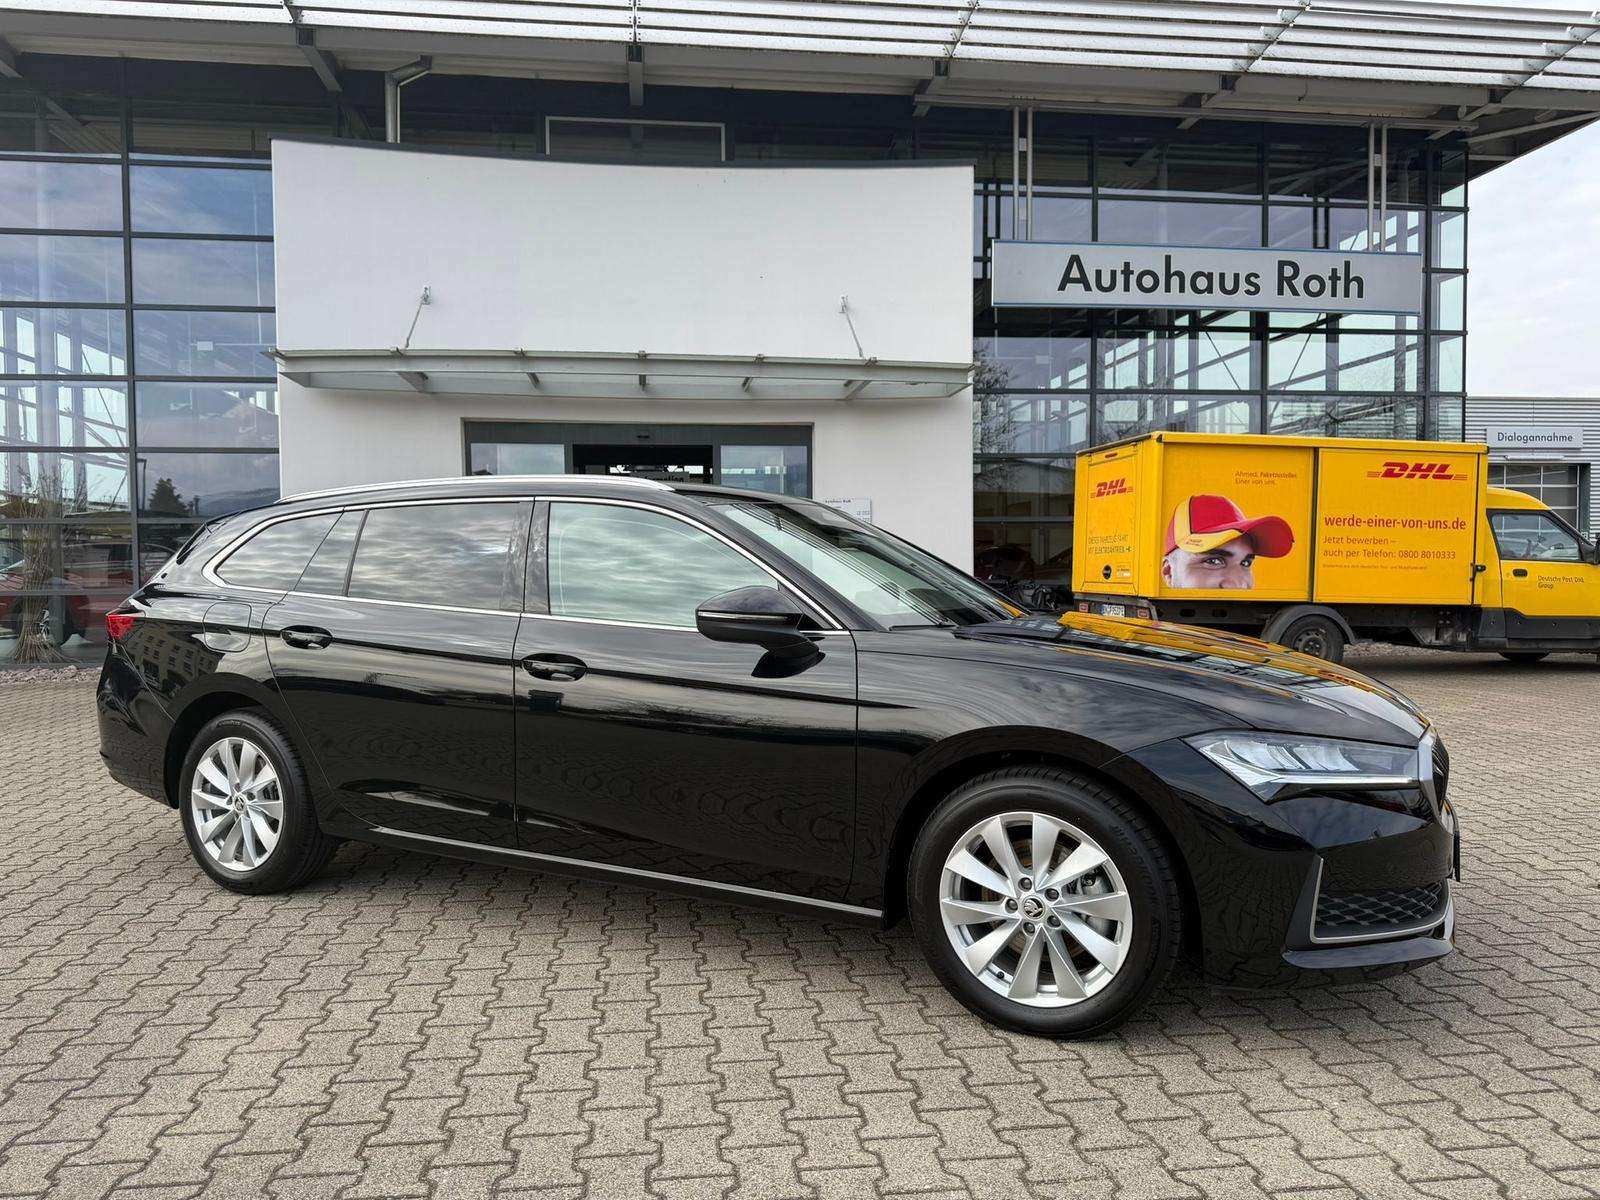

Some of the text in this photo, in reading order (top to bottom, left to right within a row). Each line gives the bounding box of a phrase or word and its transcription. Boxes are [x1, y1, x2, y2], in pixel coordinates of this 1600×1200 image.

[1057, 254, 1364, 298] Autohaus Roth
[1497, 432, 1573, 444] Dialogannahme
[1381, 462, 1455, 480] DHL
[1096, 478, 1127, 498] DHL
[1324, 514, 1467, 530] werde-einer-von-uns.de
[1323, 536, 1343, 545] Jetzt
[1346, 536, 1389, 546] bewerben
[1323, 548, 1456, 561] auch per Telefon: 0800 8010333
